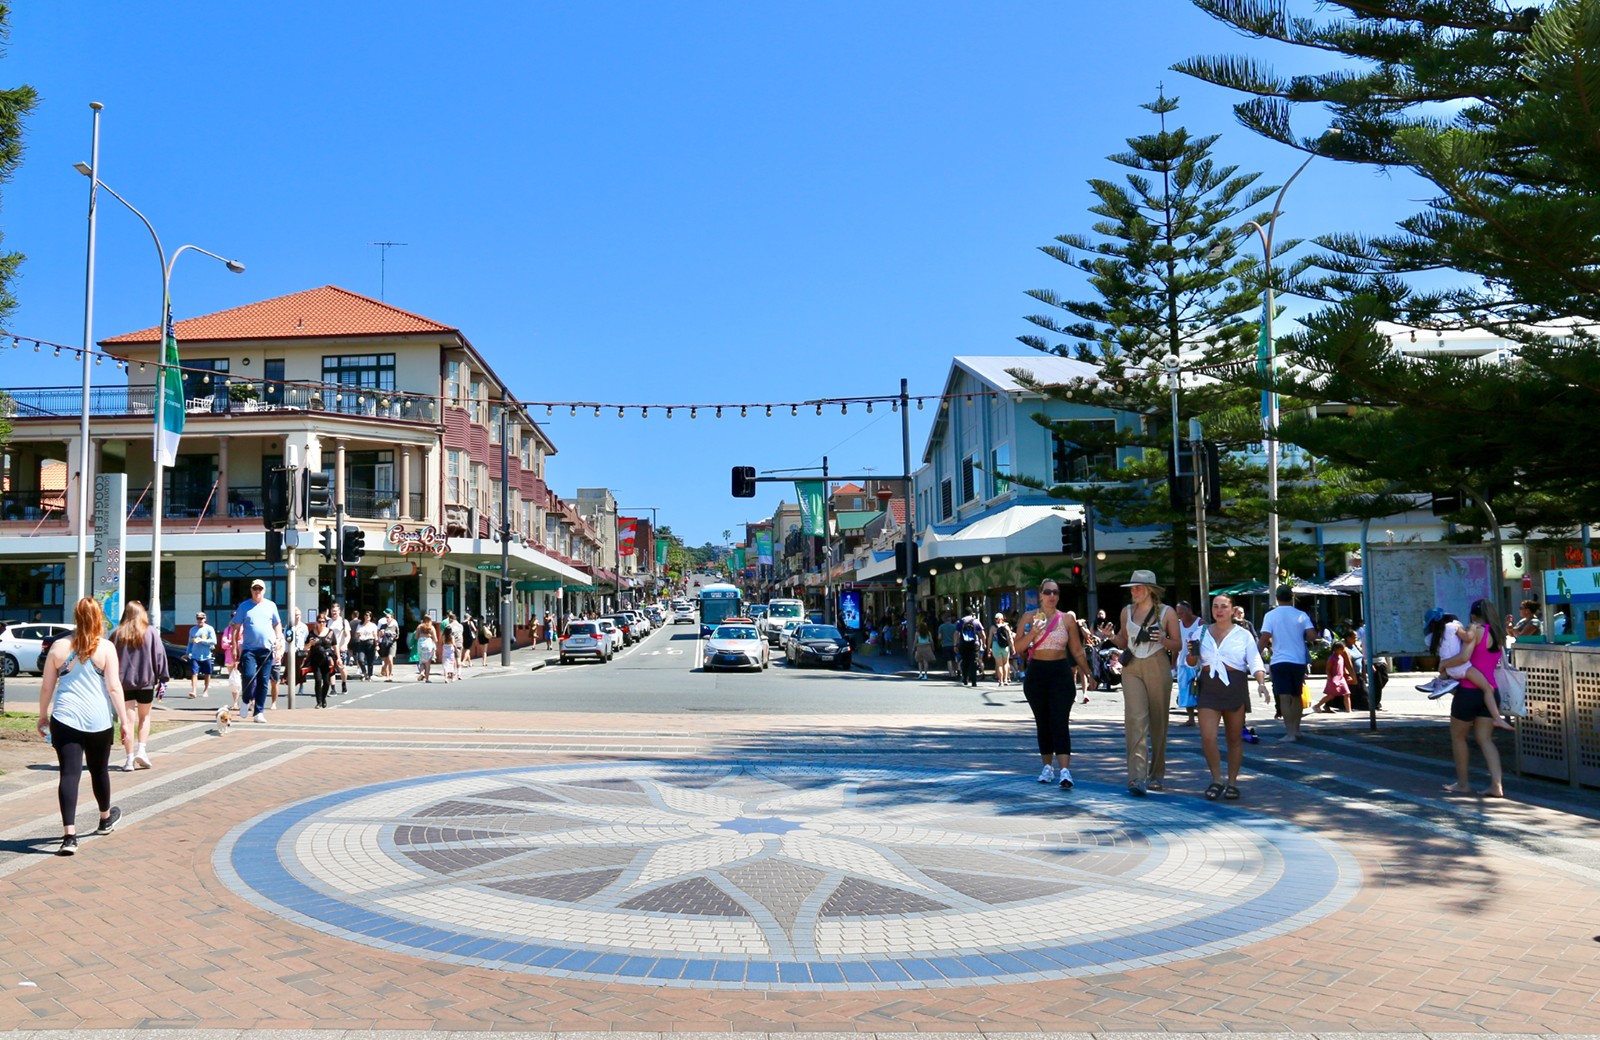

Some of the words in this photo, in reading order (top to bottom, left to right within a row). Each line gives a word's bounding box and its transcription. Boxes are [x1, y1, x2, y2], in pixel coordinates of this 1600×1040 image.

[95, 475, 104, 522] COOGEE
[94, 525, 103, 563] BEACH
[421, 526, 450, 556] Bay
